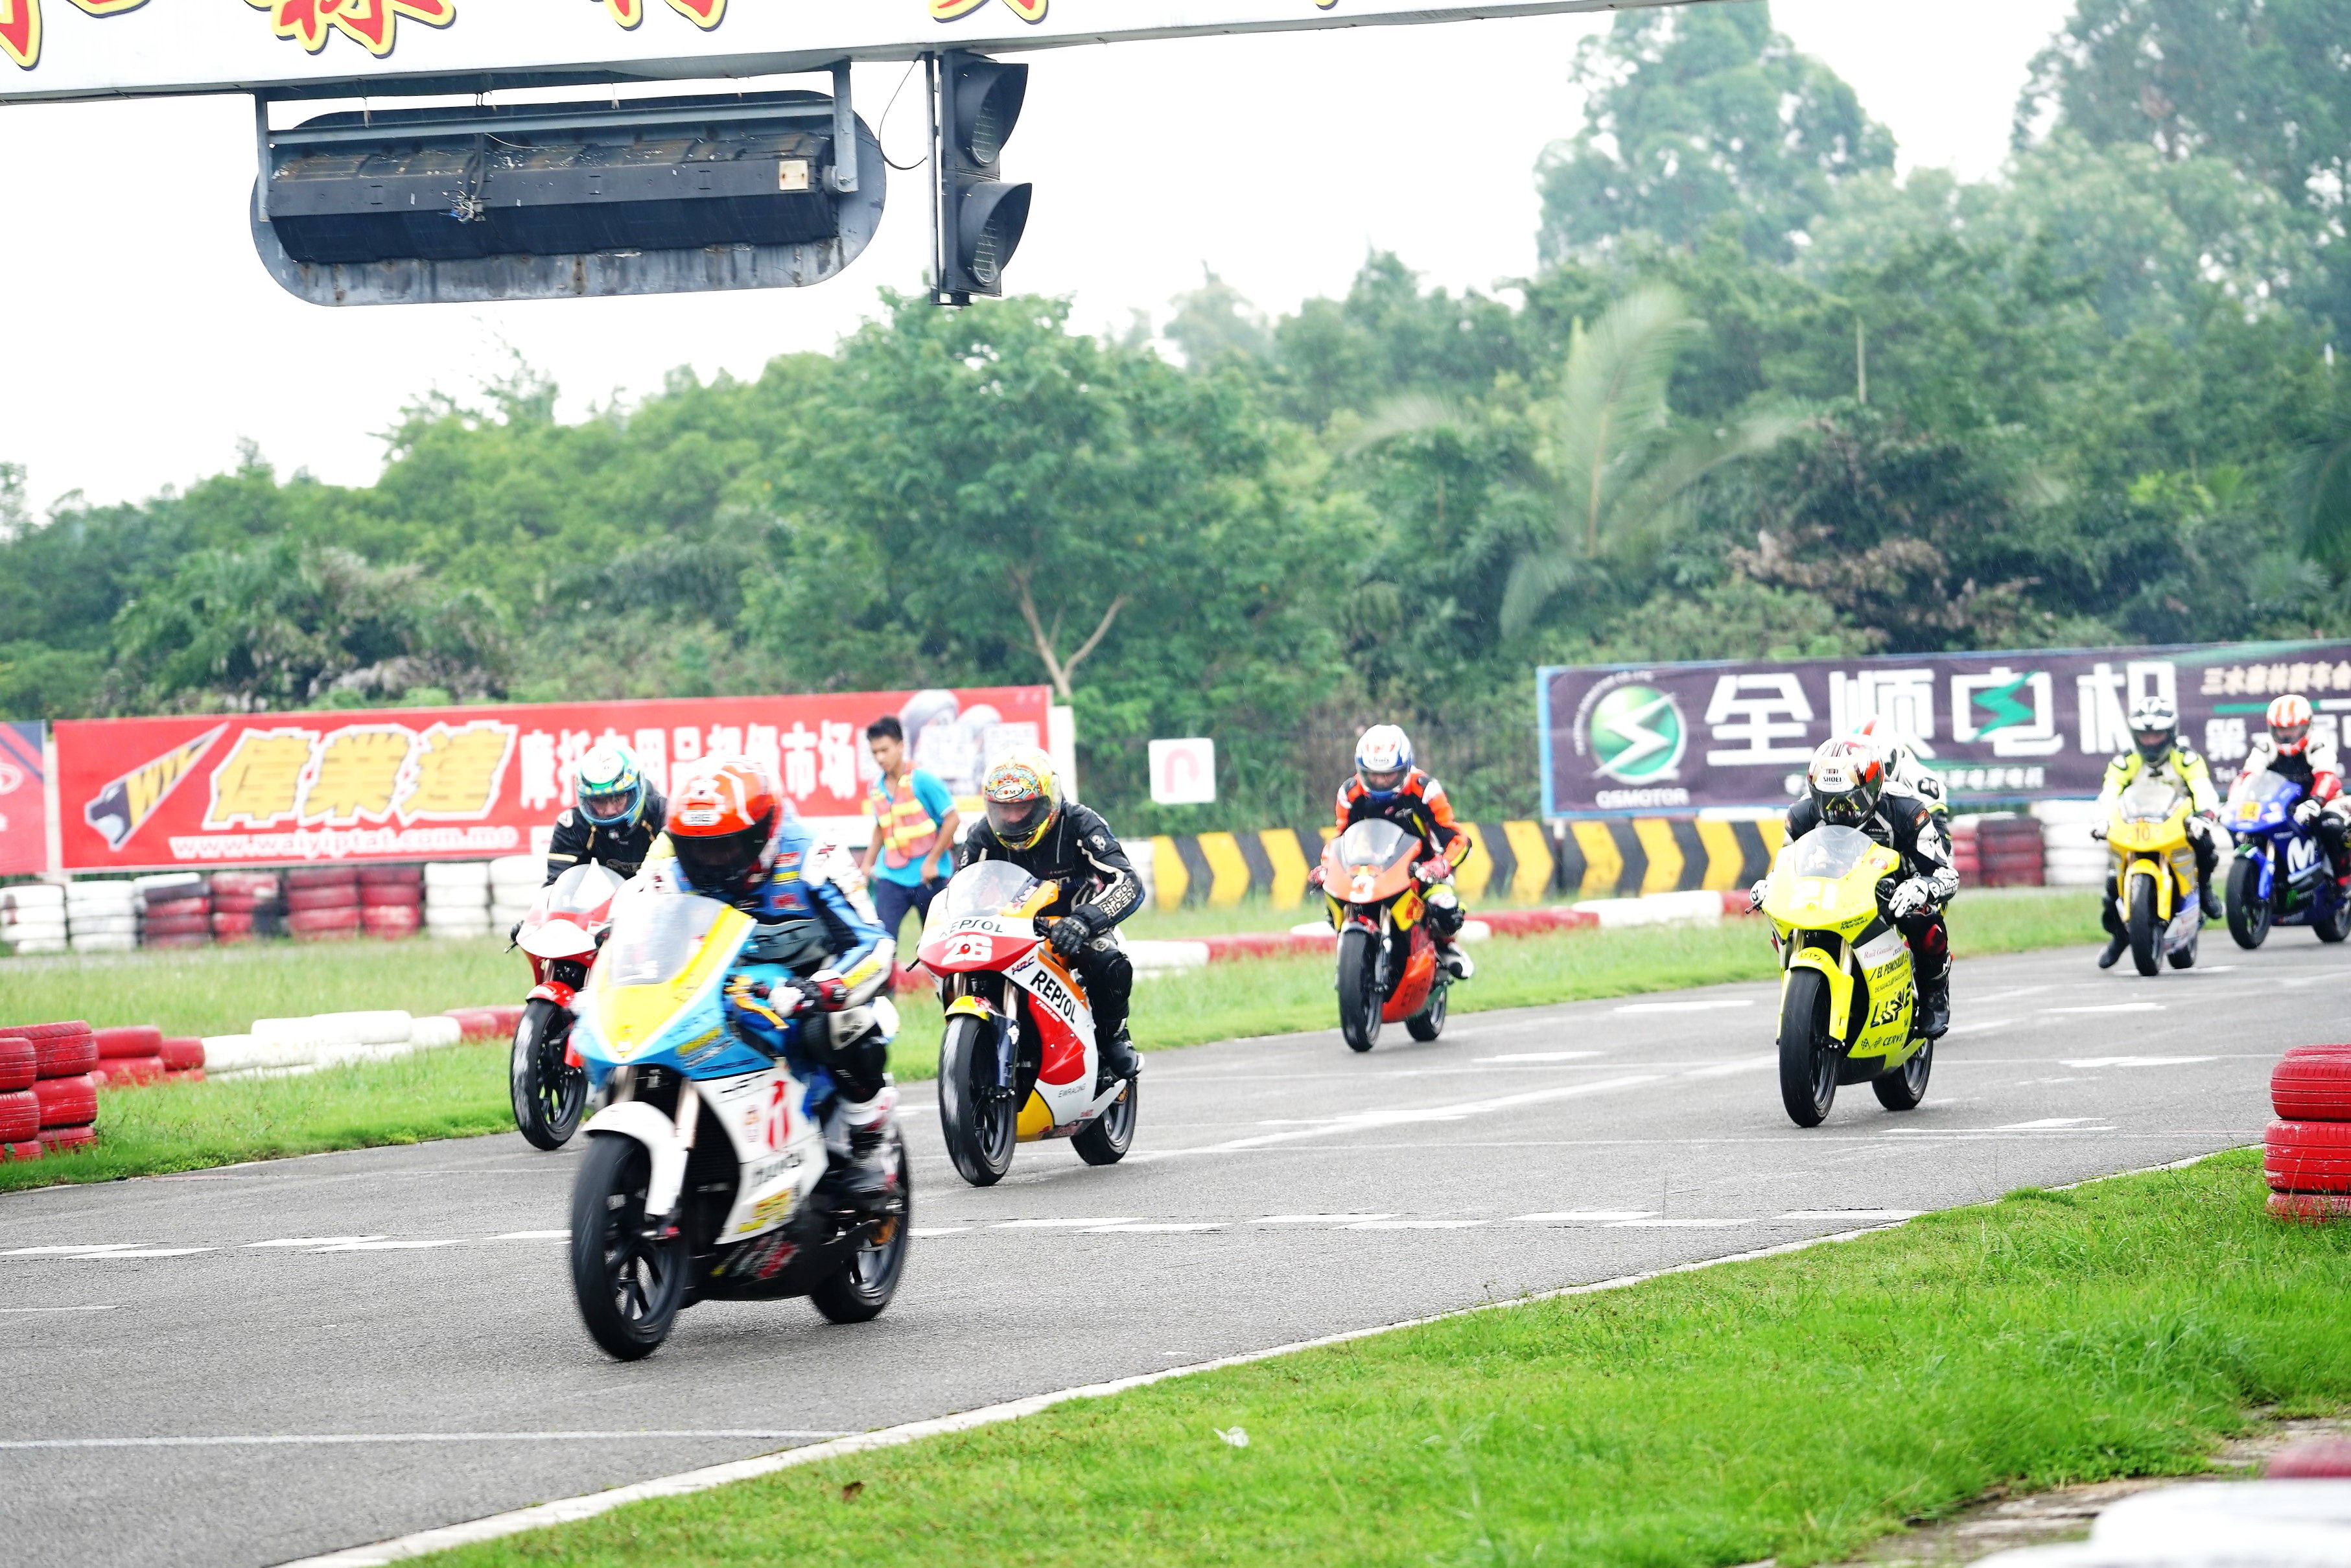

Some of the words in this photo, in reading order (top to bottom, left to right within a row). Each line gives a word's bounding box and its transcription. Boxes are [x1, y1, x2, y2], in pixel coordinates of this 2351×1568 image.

[202, 720, 519, 830] 偉業達
[2135, 826, 2150, 841] 10
[1349, 875, 1374, 903] 3
[941, 933, 992, 965] 26
[1030, 969, 1075, 1024] REPSOL
